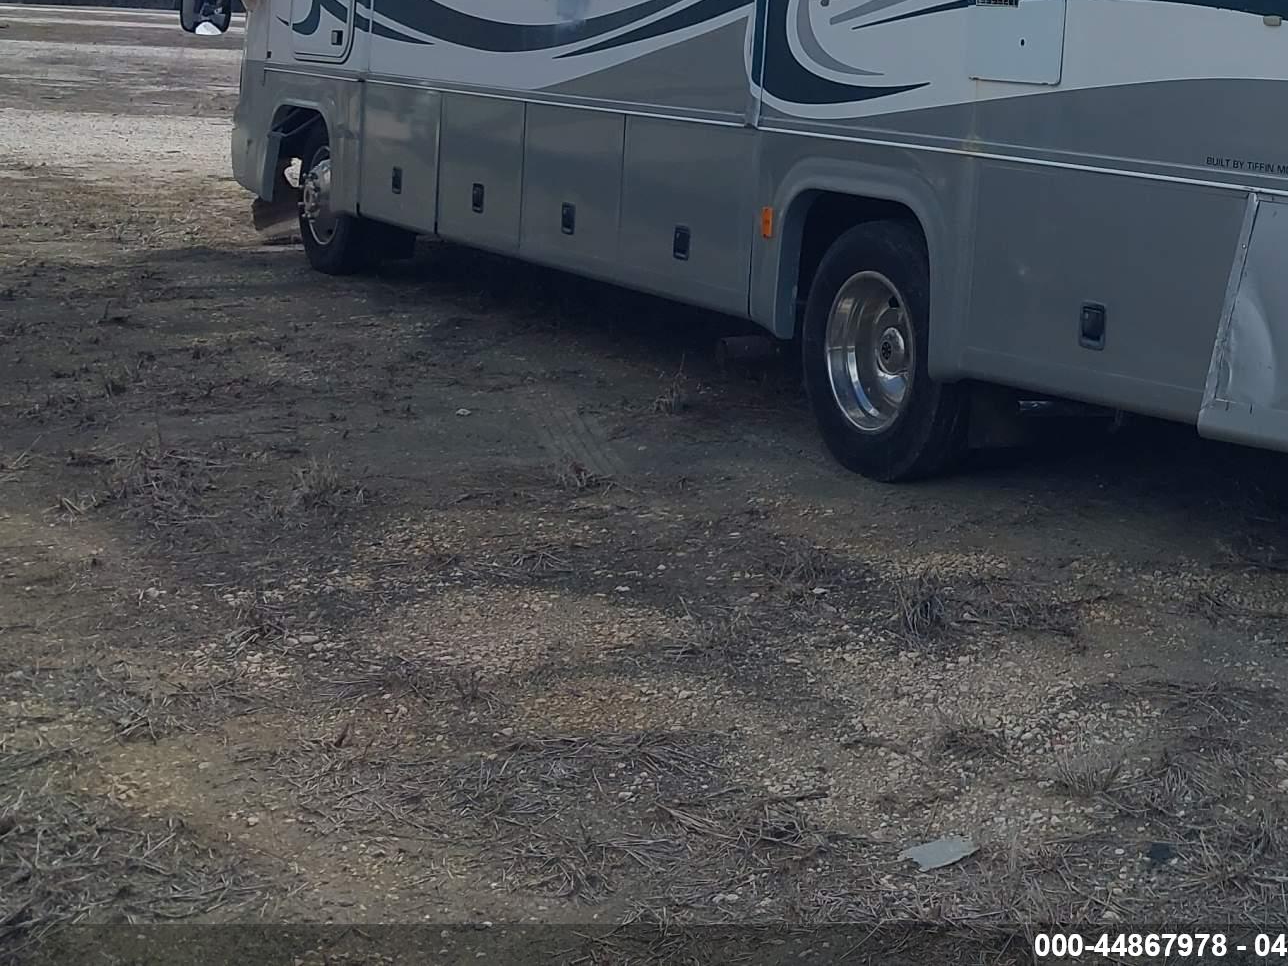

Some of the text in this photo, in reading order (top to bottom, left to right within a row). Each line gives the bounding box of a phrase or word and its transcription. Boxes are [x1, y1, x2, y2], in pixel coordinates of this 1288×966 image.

[1206, 156, 1231, 169] BUILT
[1232, 159, 1245, 170] BY
[1247, 161, 1275, 173] TIFFIN
